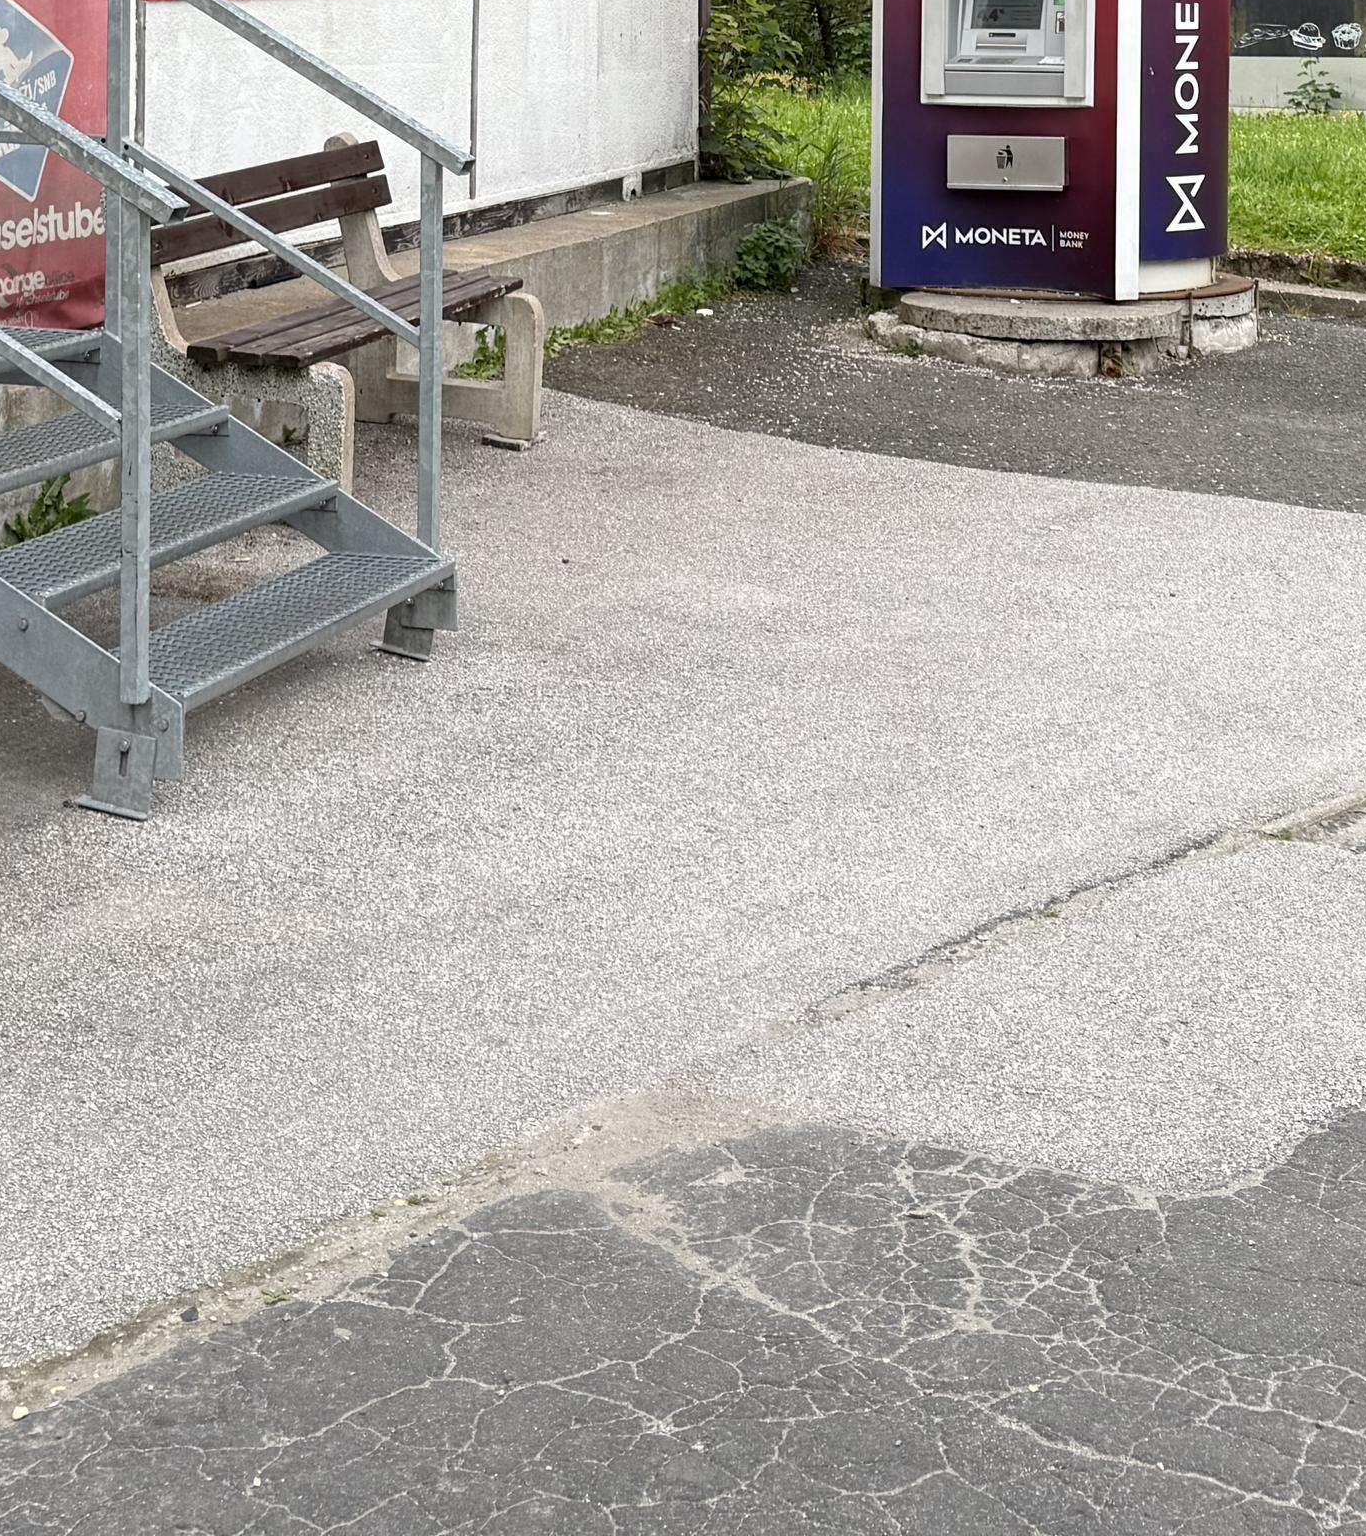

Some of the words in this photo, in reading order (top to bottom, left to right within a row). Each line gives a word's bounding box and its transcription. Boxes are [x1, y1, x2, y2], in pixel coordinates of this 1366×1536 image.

[954, 227, 1048, 247] MONETA
[1059, 230, 1090, 241] MONEY
[1059, 240, 1084, 249] BANK
